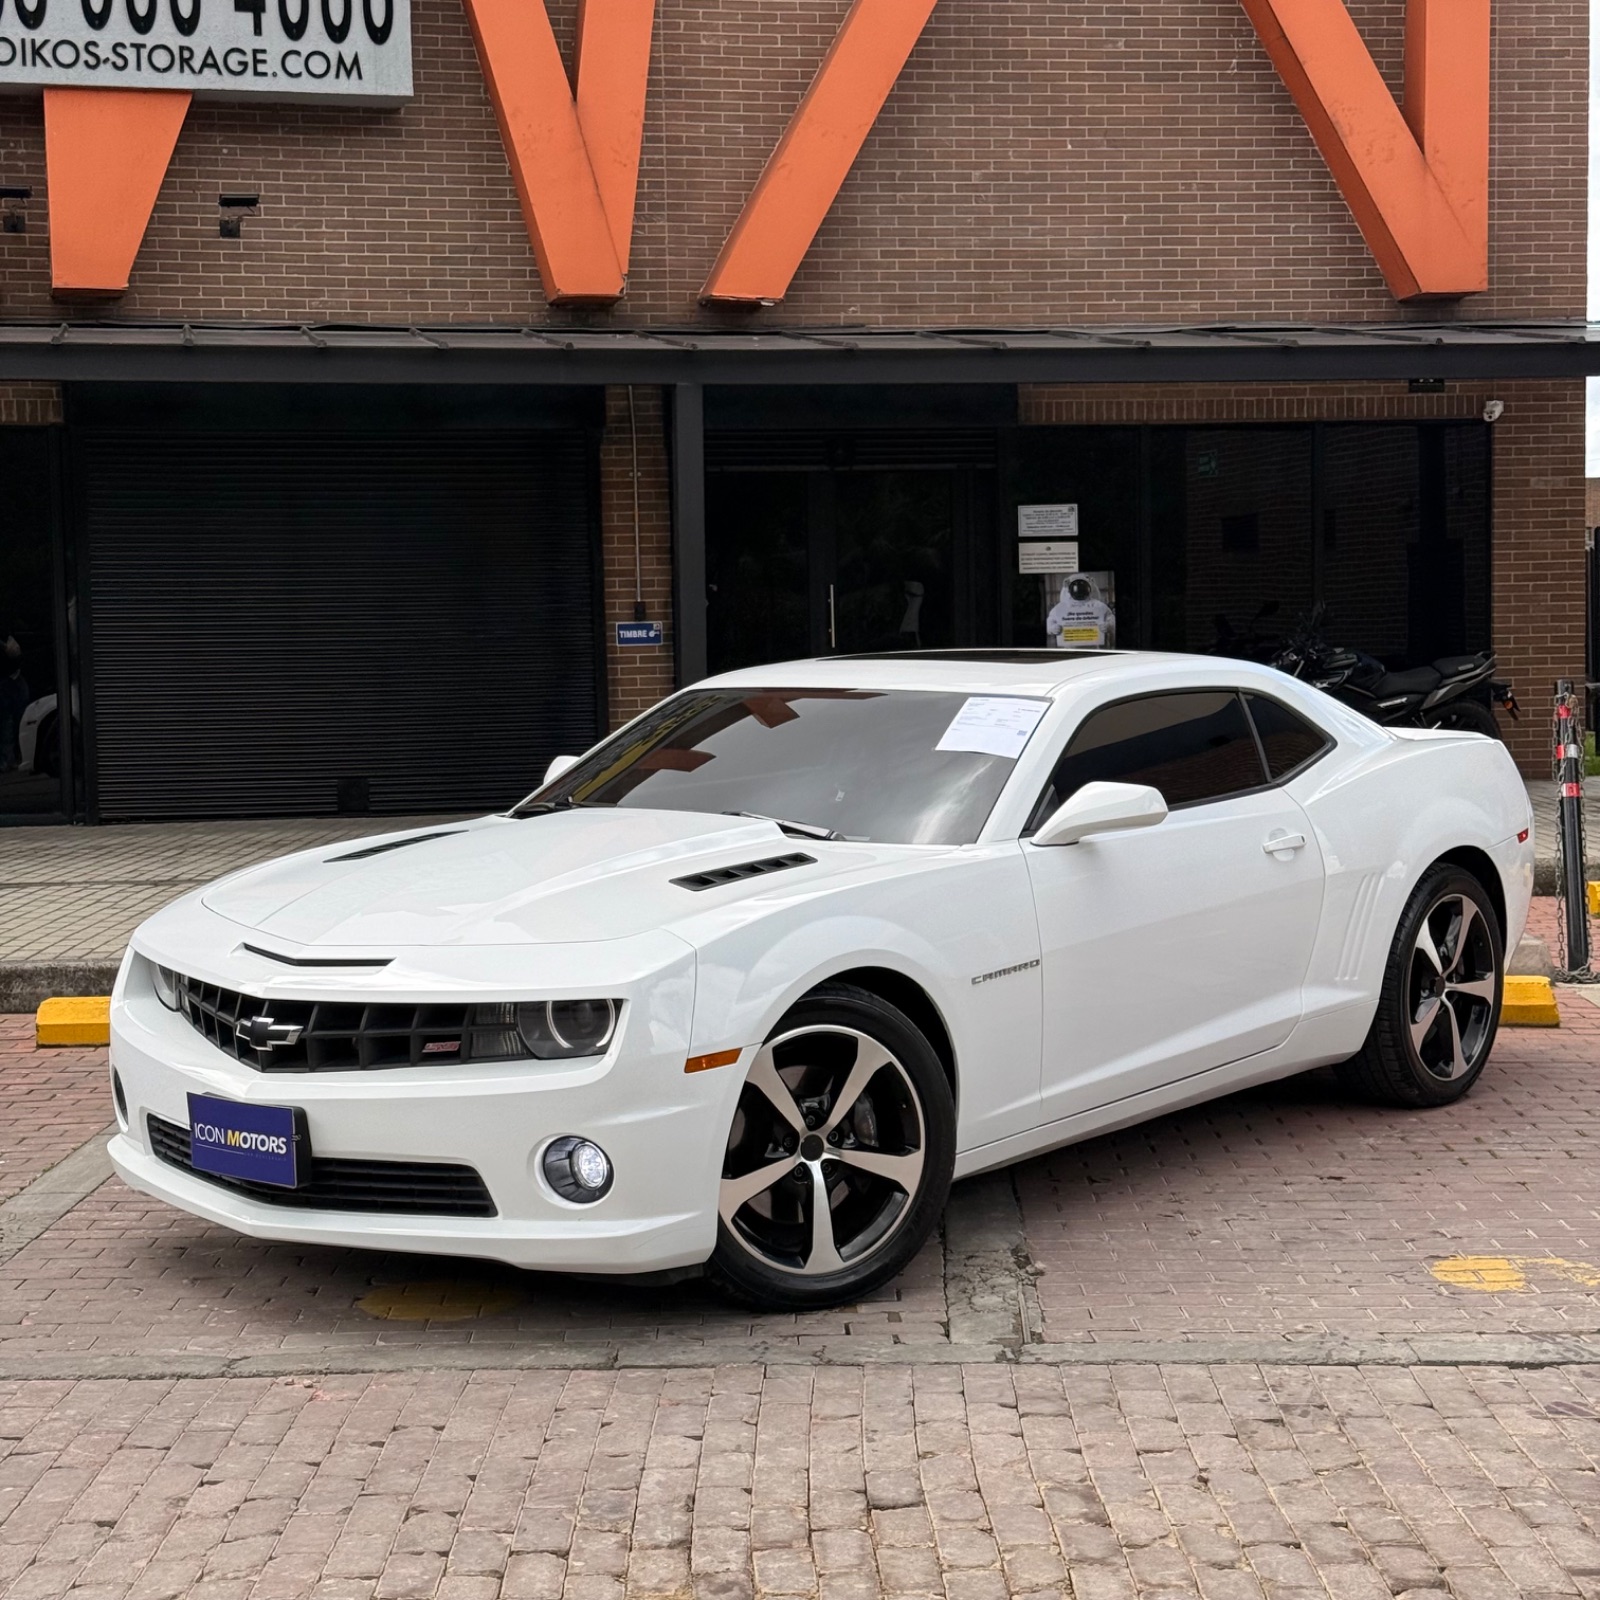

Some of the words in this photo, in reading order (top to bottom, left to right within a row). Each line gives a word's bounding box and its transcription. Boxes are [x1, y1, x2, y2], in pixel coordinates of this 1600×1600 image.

[619, 630, 647, 638] TIMBRE
[971, 958, 1040, 985] CAMARO
[194, 1122, 225, 1145] ICON
[227, 1129, 287, 1154] MOTORS
